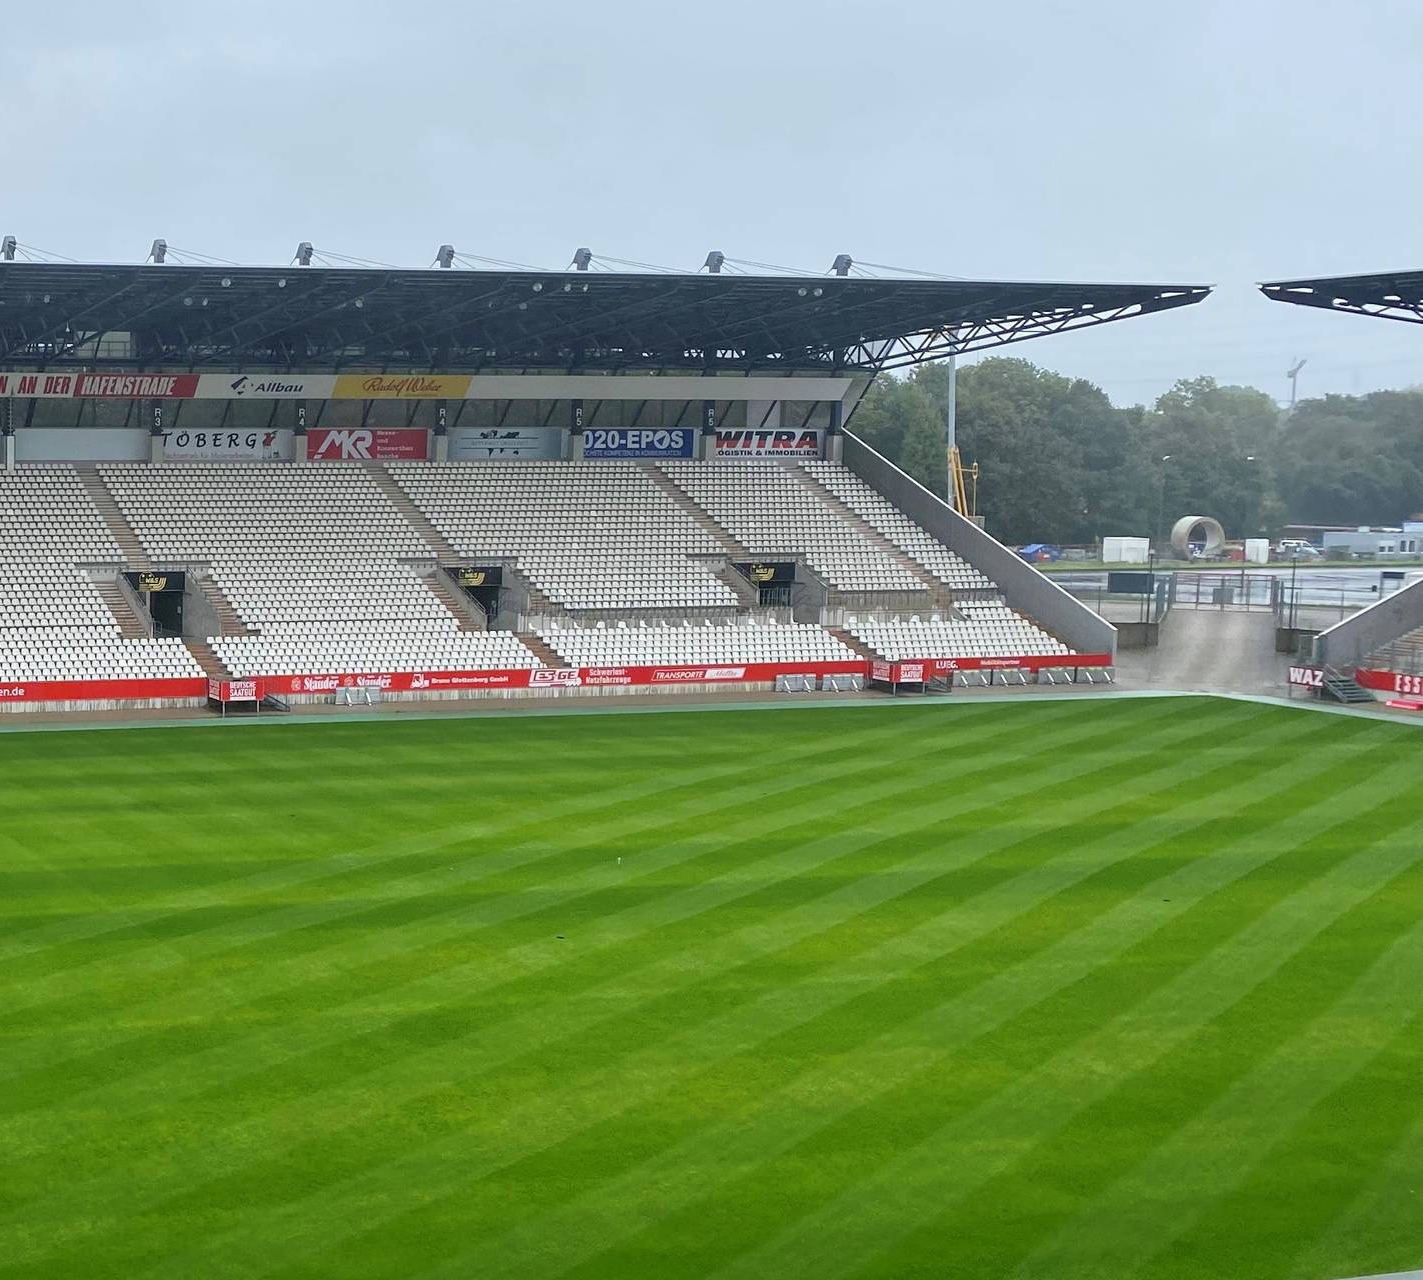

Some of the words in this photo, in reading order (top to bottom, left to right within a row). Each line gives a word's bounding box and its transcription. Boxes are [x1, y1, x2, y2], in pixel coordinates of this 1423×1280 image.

[17, 376, 38, 395] AN
[43, 376, 71, 395] DER
[255, 382, 304, 393] Allbau
[362, 375, 409, 396] Rudolf
[314, 430, 373, 459] MKR
[716, 431, 817, 448] WITRA
[304, 675, 339, 691] Stauder
[357, 674, 392, 688] Stauder
[656, 671, 703, 680] TRANSPORTE
[1289, 667, 1324, 686] WAZ
[1395, 674, 1421, 693] ESS
